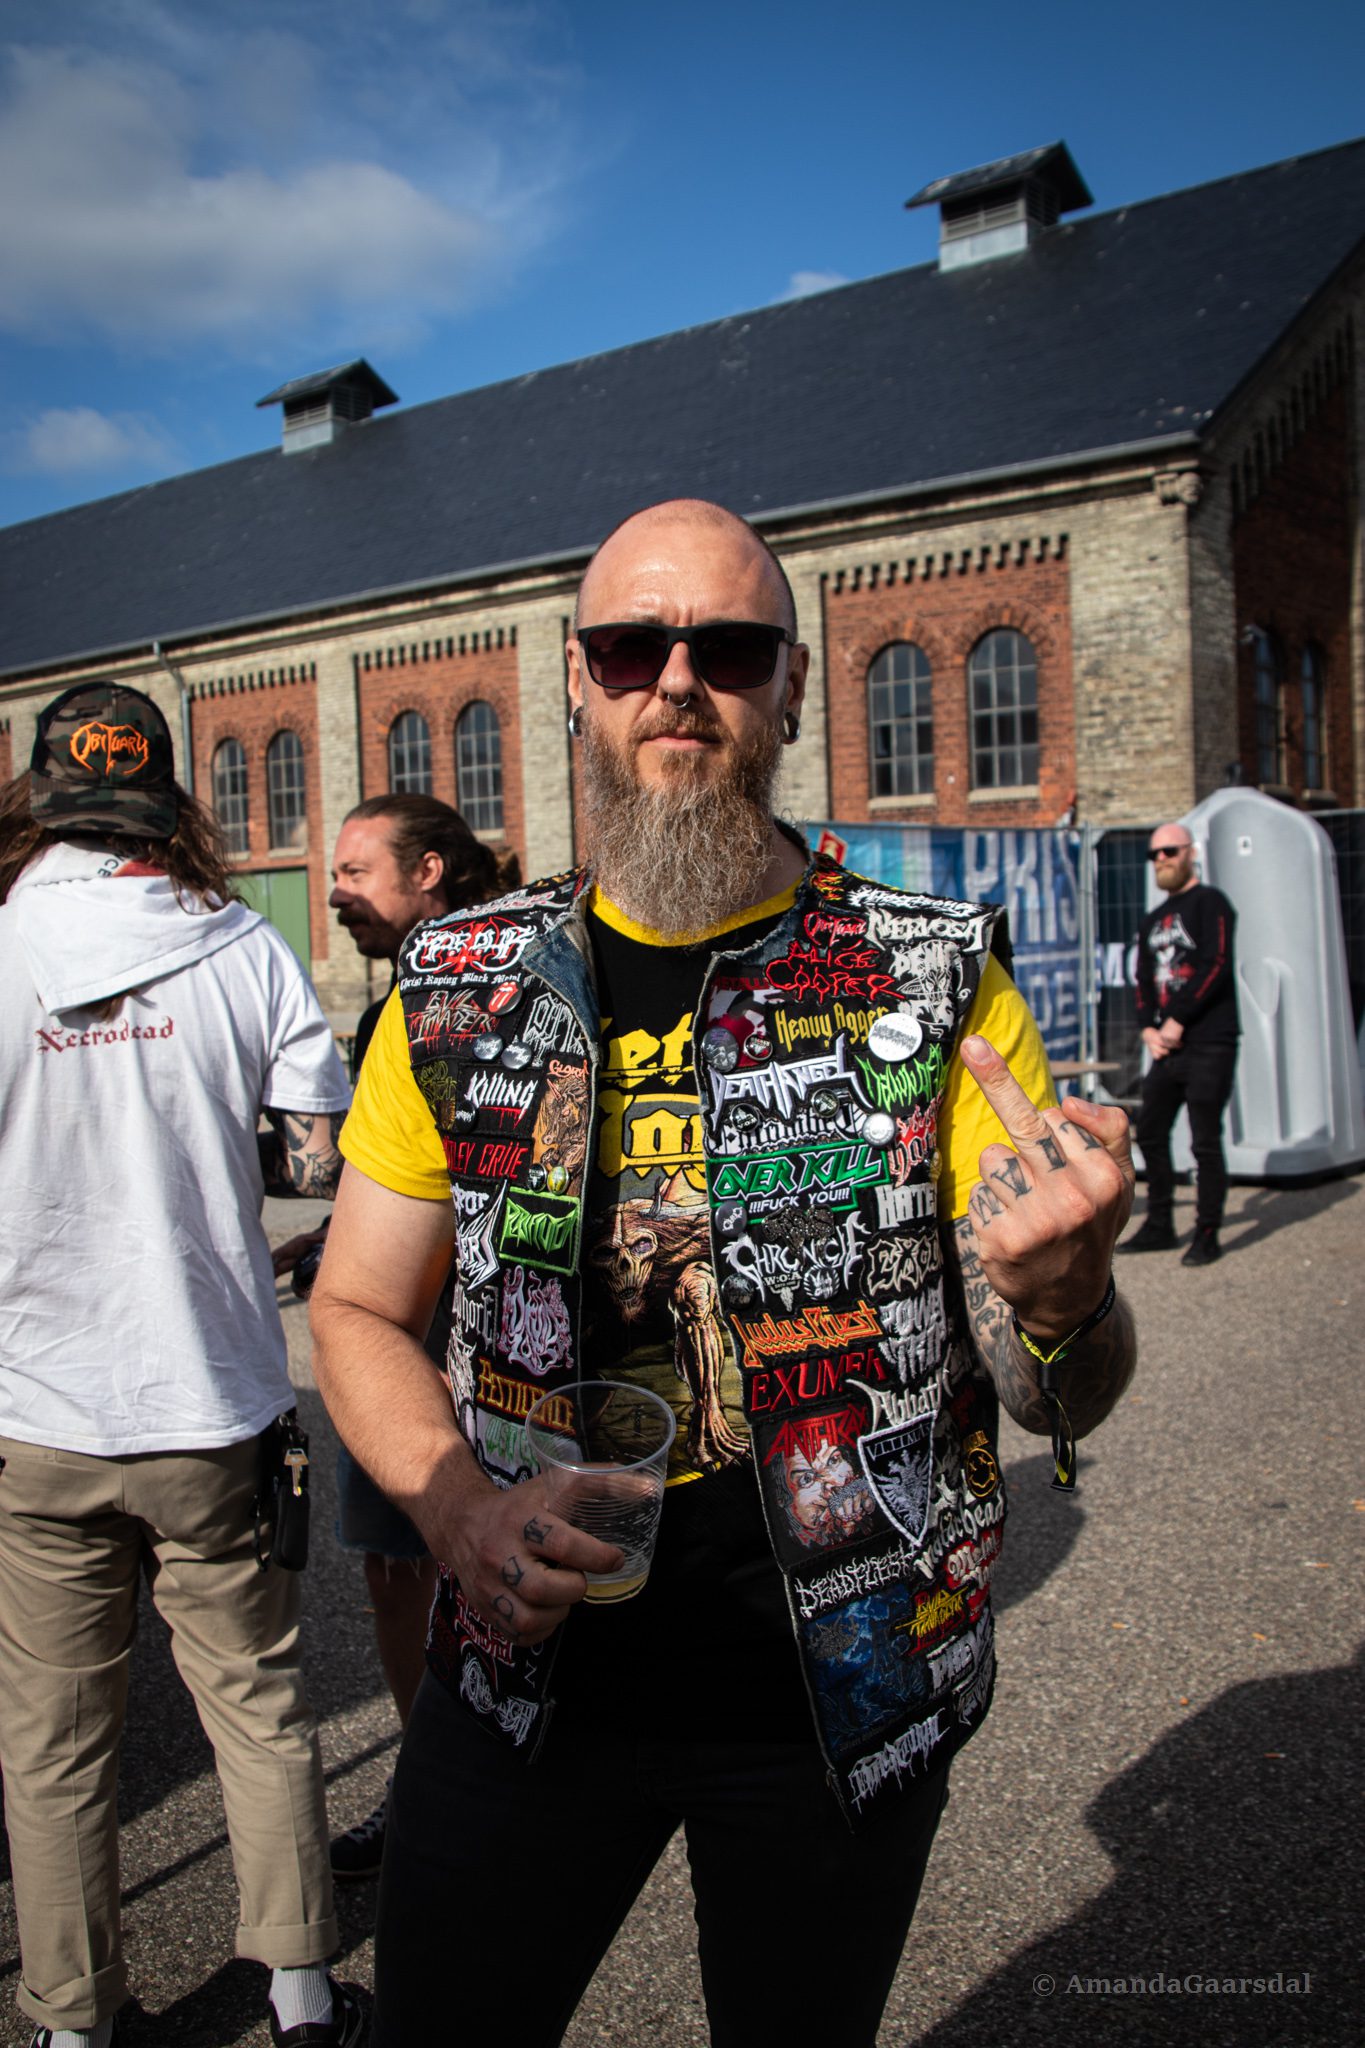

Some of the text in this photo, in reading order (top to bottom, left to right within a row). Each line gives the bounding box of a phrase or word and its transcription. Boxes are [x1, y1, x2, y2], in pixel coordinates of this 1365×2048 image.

[864, 907, 993, 951] NERVOSA
[787, 940, 880, 969] ALICE
[423, 975, 458, 987] Raping
[461, 973, 489, 984] Black
[491, 972, 522, 984] Metal
[766, 961, 905, 1003] COOPER
[36, 1016, 174, 1053] Necrodead
[775, 1008, 832, 1052] Heavy
[478, 1142, 528, 1179] CRÜE
[749, 1187, 850, 1213] !!!FUCK YOU!!!
[763, 1404, 868, 1466] ANTHRAX
